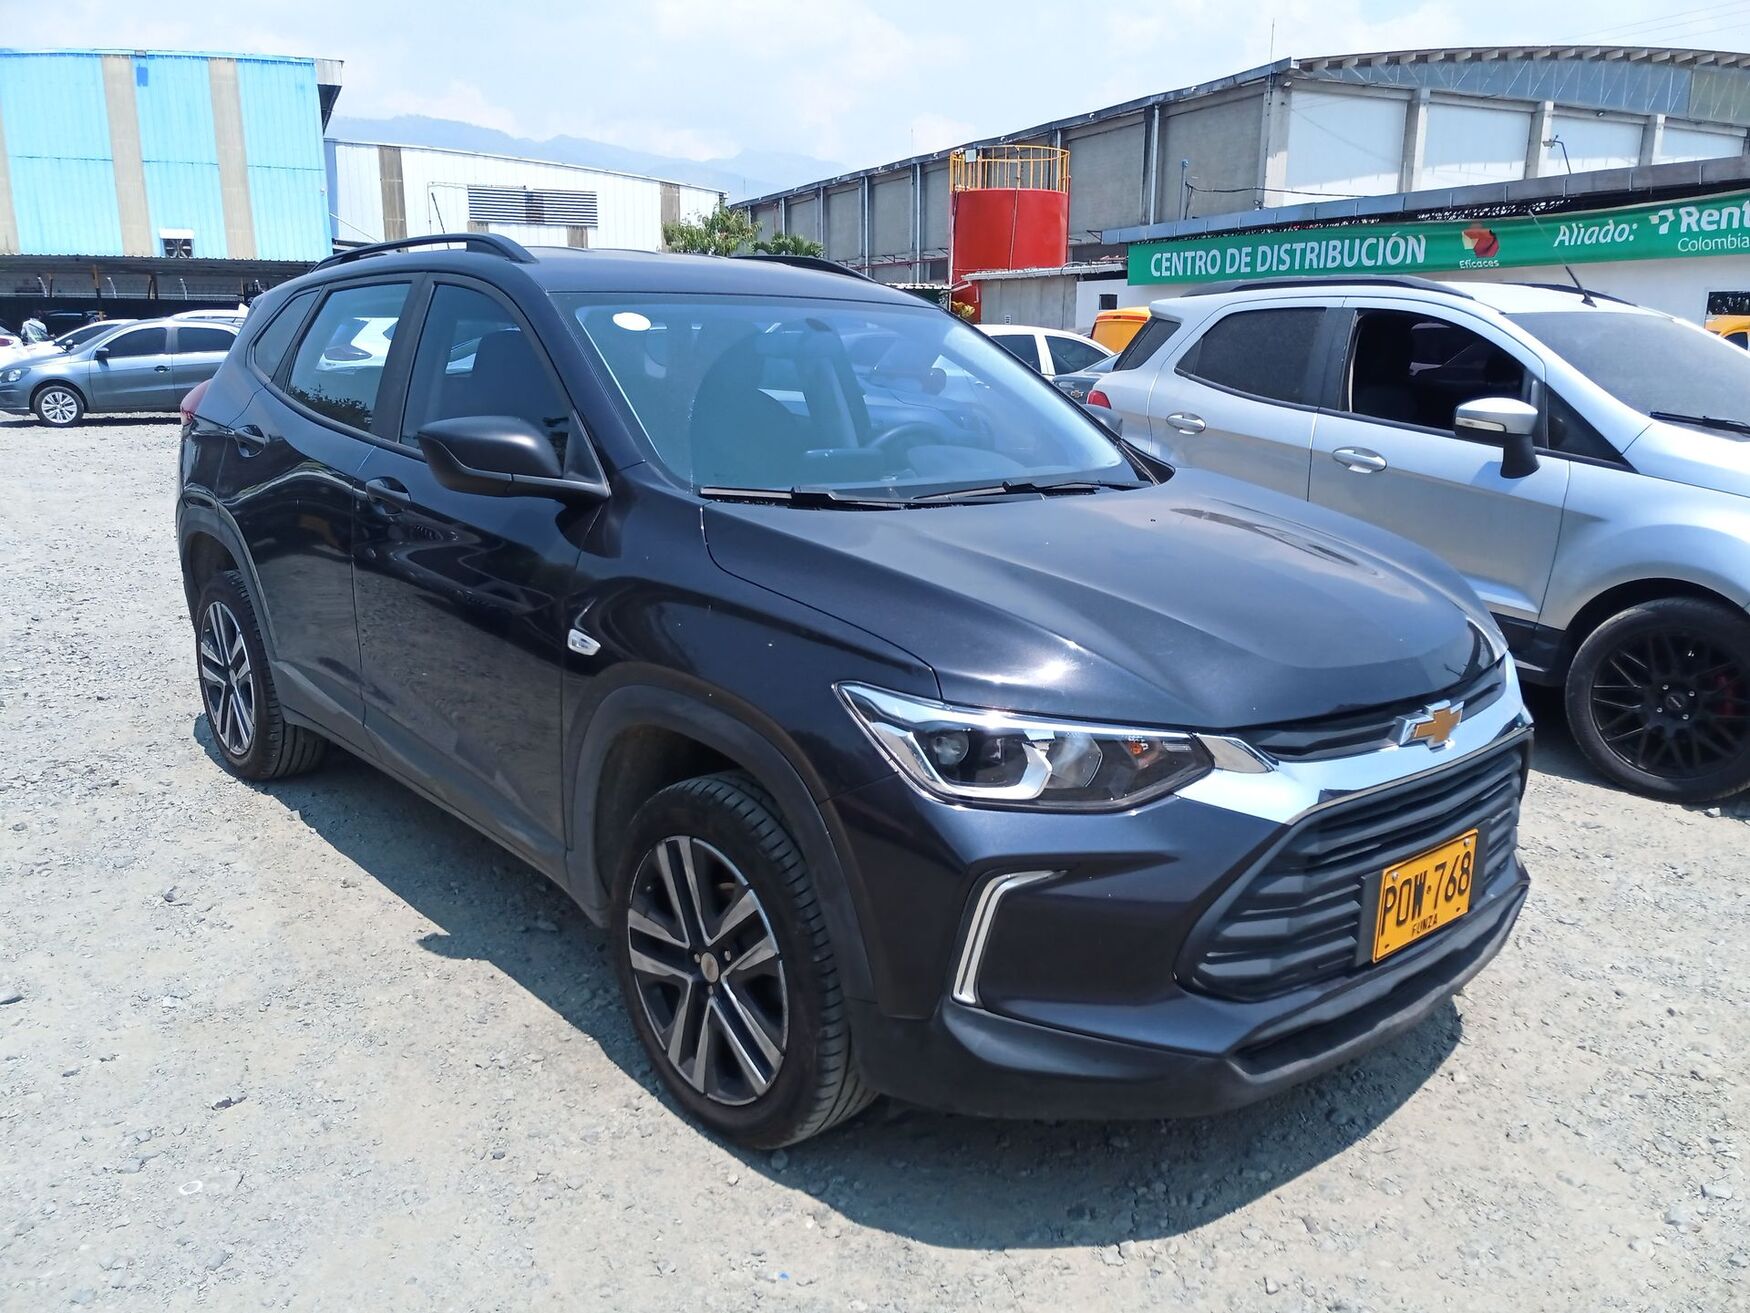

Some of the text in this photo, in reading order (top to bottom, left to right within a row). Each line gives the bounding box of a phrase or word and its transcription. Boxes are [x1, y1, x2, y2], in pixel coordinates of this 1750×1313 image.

[1553, 219, 1639, 248] Aliado:
[1677, 233, 1750, 252] Colombia
[1150, 231, 1427, 277] CENTRO DE DISTRIBUCIÓN
[1459, 259, 1500, 269] Eficaces
[1411, 913, 1438, 937] FUNZA
